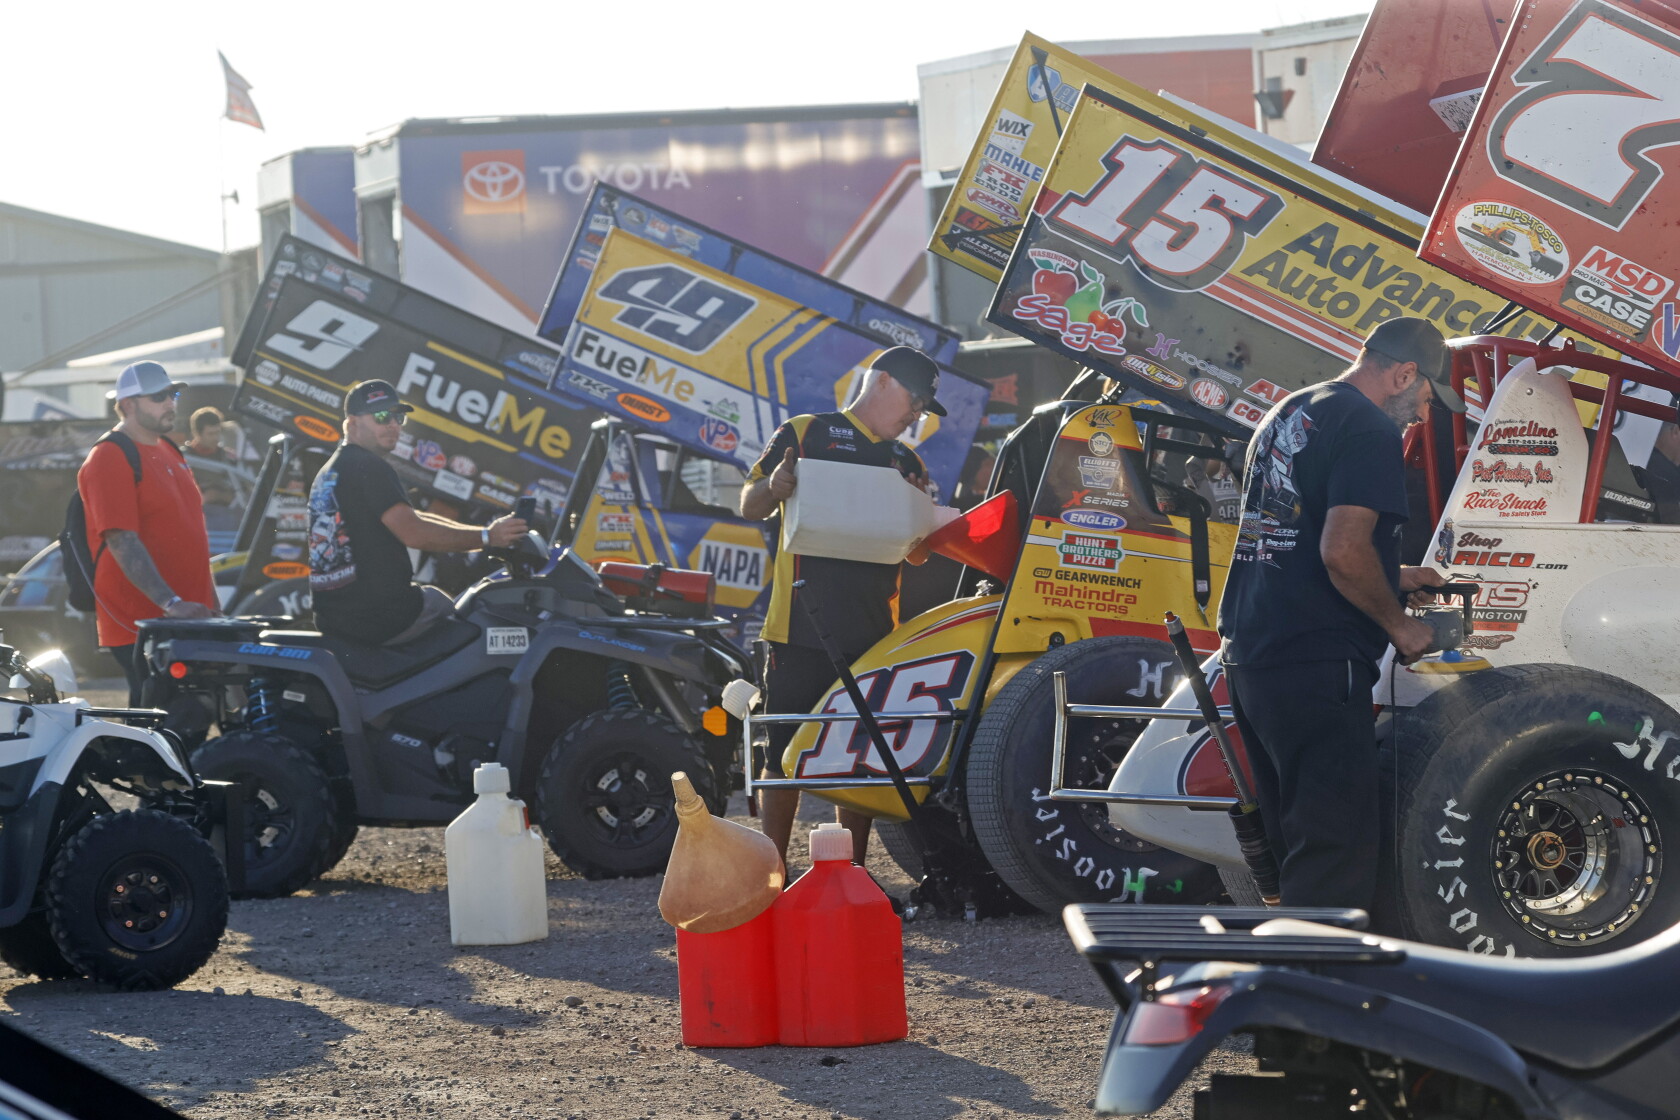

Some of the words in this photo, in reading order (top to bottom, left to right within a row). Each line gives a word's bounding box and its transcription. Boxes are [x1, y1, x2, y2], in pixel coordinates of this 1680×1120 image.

[997, 117, 1031, 137] WIX
[985, 143, 1044, 183] MAHLE
[539, 162, 691, 195] TOYOTA
[973, 177, 1020, 203] ENDS
[987, 175, 1021, 196] ROD
[1046, 136, 1280, 286] 15
[1474, 204, 1563, 254] PHILLIPS-TOSCO
[1030, 249, 1078, 269] WASHINGTON
[1471, 250, 1517, 274] HARMONY
[1582, 248, 1666, 296] MSD
[1240, 249, 1360, 319] Auto
[1573, 268, 1589, 279] PRO
[1590, 275, 1606, 287] MAG
[597, 263, 758, 358] 49
[1575, 285, 1652, 329] CASE
[1576, 304, 1638, 335] CONSTRUCTION
[265, 299, 380, 370] 9
[574, 330, 695, 402] FuelMe
[280, 374, 310, 395] AUTO
[306, 384, 342, 409] PARTS
[1194, 381, 1225, 406] ACME
[397, 352, 572, 459] FuelMe
[1477, 420, 1559, 451] Lomelino
[1463, 491, 1501, 510] Race
[1498, 492, 1548, 511] Shack
[1604, 490, 1652, 510] ULTRA-SHIELD
[1069, 513, 1119, 527] ENGLER
[1062, 544, 1120, 560] BROTHERS
[1075, 536, 1107, 549] HUNT
[1457, 531, 1503, 549] Shop
[703, 544, 761, 586] NAPA
[1034, 580, 1138, 605] Mahindra
[1055, 570, 1141, 590] GEARWRENCH
[1042, 596, 1129, 615] TRACTORS
[489, 635, 499, 647] AT
[797, 652, 970, 779] 15
